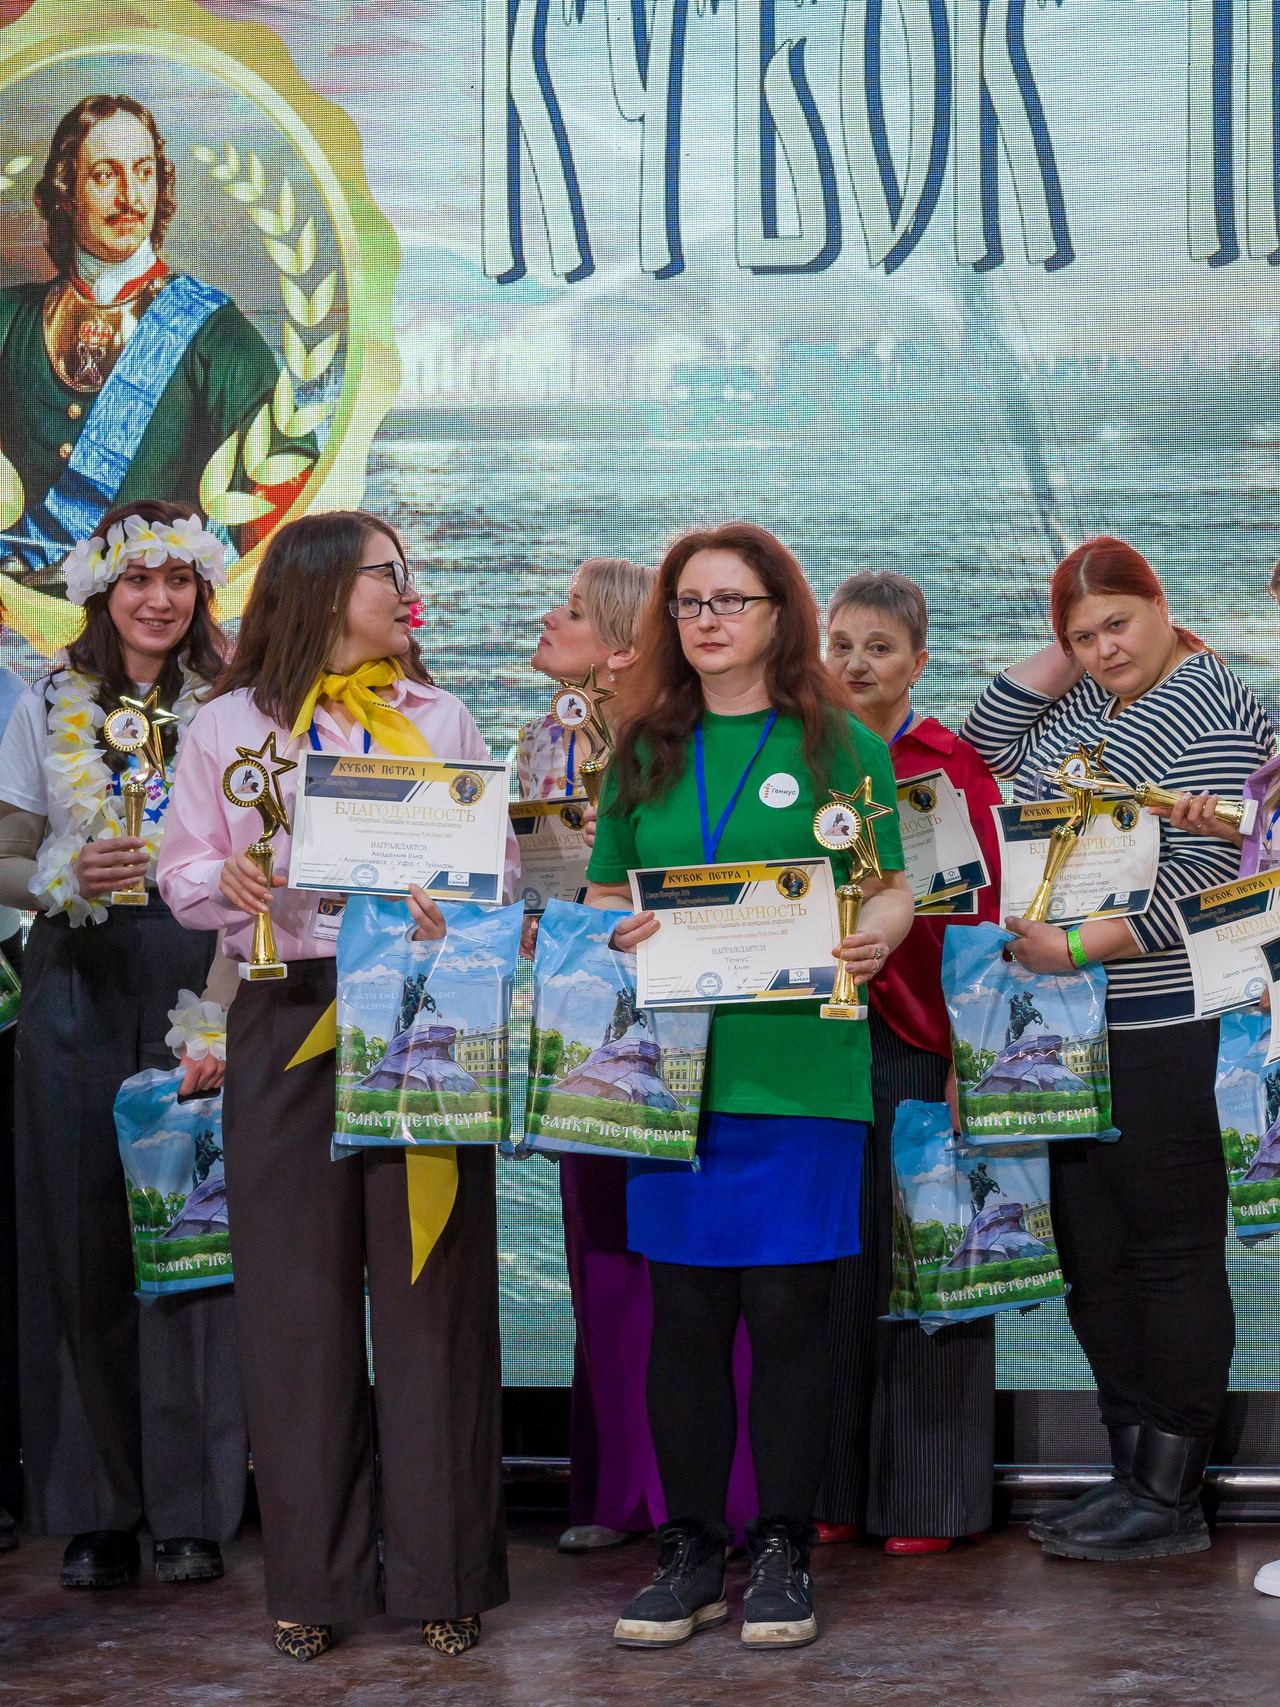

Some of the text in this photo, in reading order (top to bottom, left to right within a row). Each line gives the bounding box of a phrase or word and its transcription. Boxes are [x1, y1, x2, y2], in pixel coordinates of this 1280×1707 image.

[339, 762, 375, 774] КУБОК
[382, 764, 415, 776] ПЕТРА
[772, 787, 797, 796] Гениус
[334, 801, 476, 823] БЛАГОДАРНОСТЬ
[1024, 805, 1074, 817] КУБОК ПЕТ
[371, 841, 428, 851] НАГРАЖДАЕТСЯ
[1029, 835, 1136, 855] БЛАРНОСТЬ
[371, 851, 423, 860] Академия Ума
[668, 871, 703, 884] КУБОК
[709, 870, 741, 881] ПЕТРА
[1203, 888, 1233, 905] КУБОК
[1236, 880, 1265, 895] ПЕТРА
[673, 903, 808, 925] БЛАГОДАРНОСТЬ
[711, 945, 766, 955] НАГРАЖДАЕТСЯ
[346, 1111, 492, 1128] САНКТ-ПЕТЕРБУРГ
[966, 1106, 1098, 1127] САНКТ-ПЕТЕРБУРГ
[540, 1114, 690, 1145] САНКТ-ПЕТЕРБУРГ
[157, 1254, 233, 1273] САНКТ-ПЕТ
[941, 1269, 1062, 1303] САНКТ-ПЕТЕРБУРГ
